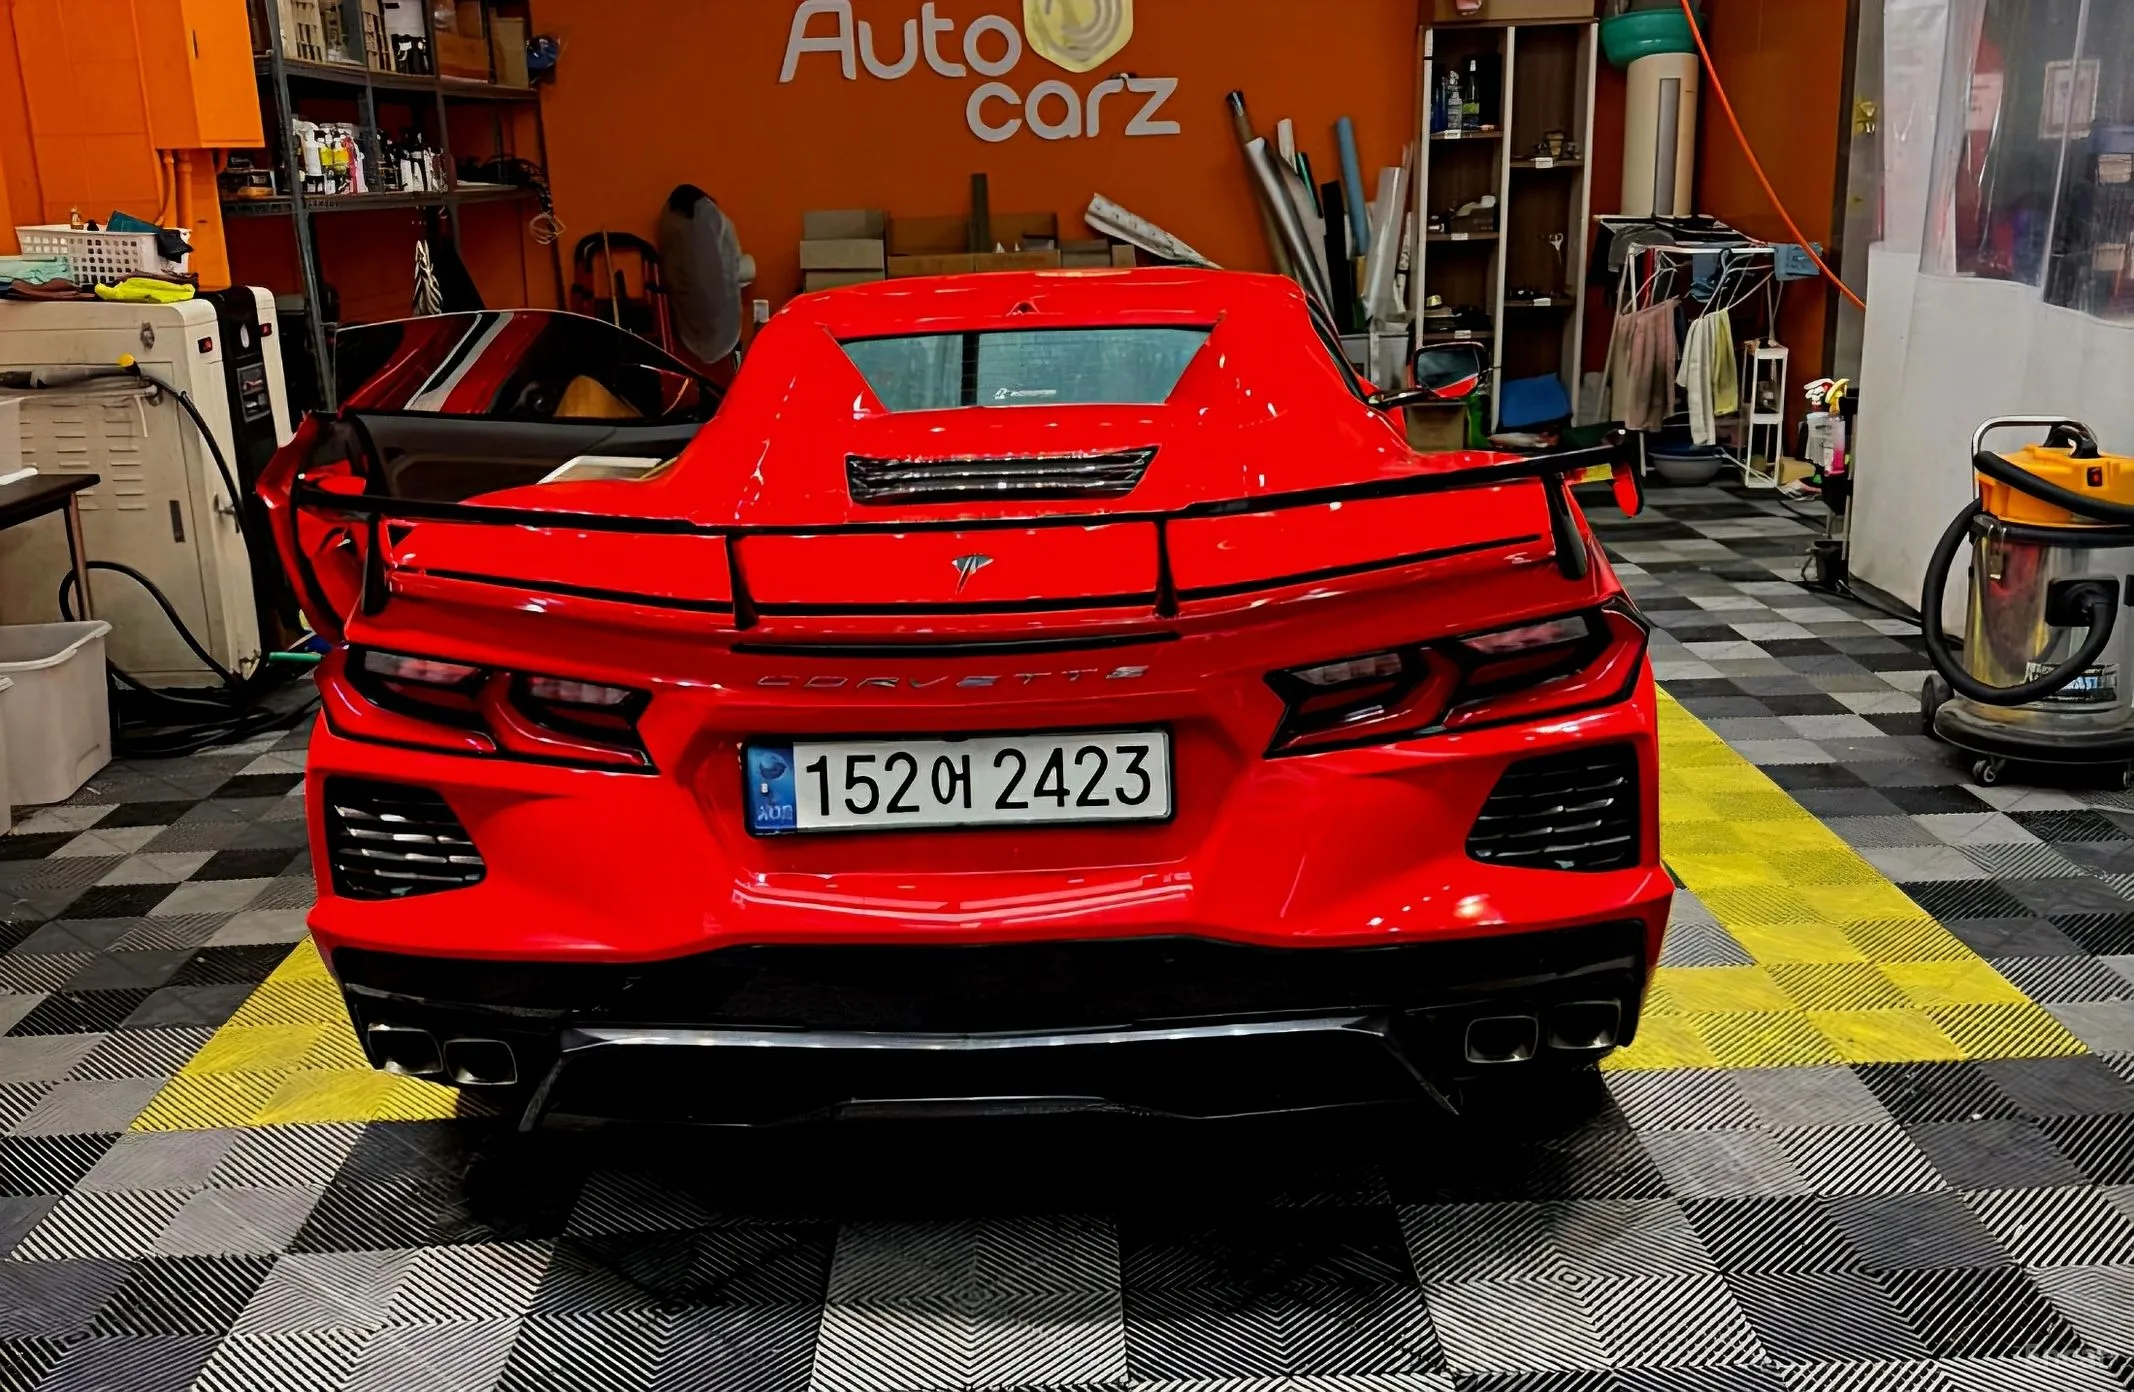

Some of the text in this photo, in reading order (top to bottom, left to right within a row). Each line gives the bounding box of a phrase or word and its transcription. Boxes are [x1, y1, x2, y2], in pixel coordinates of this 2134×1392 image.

[779, 0, 1022, 83] Auto
[965, 77, 1181, 142] carz
[757, 664, 1150, 689] CORVETTE
[993, 745, 1152, 811] 2423
